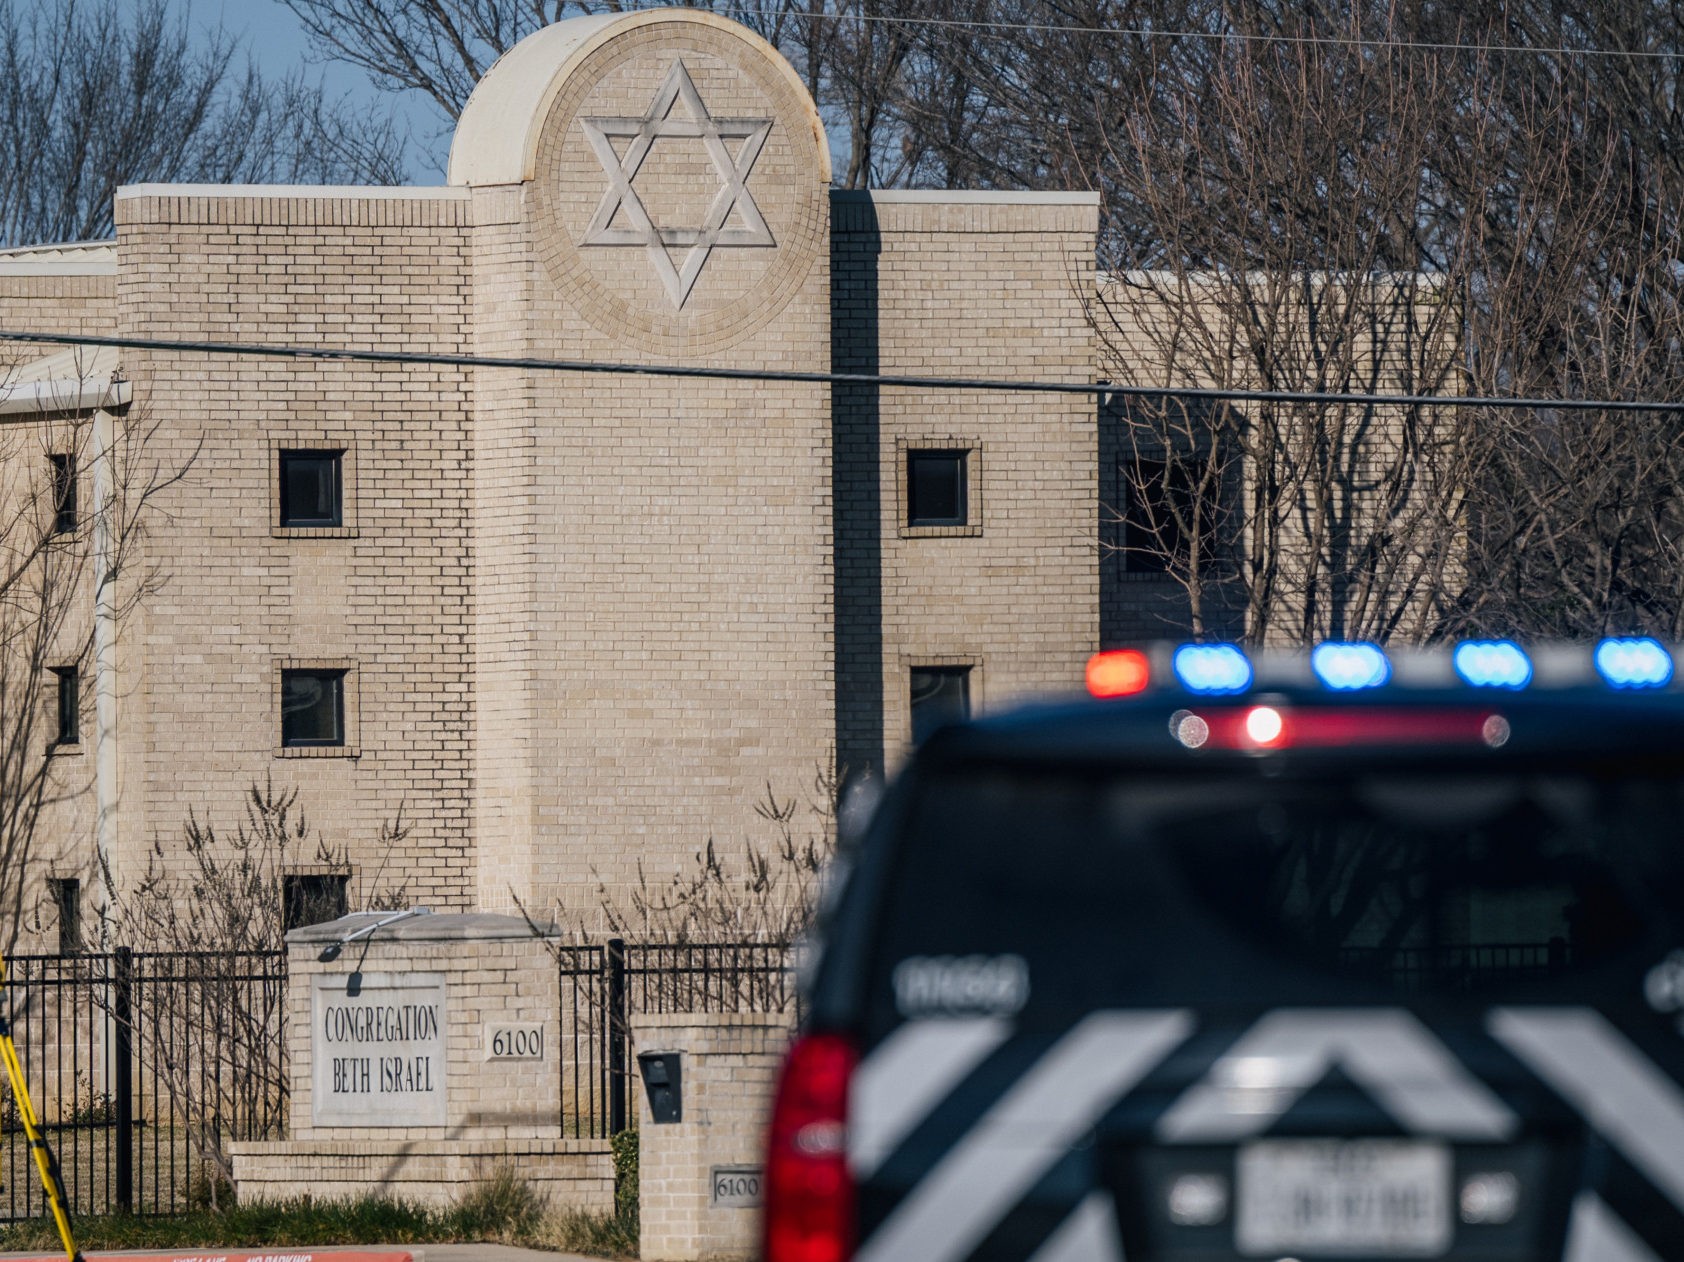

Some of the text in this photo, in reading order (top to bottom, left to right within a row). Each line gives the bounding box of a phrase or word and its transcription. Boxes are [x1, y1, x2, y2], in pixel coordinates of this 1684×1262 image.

[325, 1005, 439, 1043] CONGREGATION
[493, 1029, 540, 1056] 6100
[333, 1056, 434, 1093] BETH ISRAEL
[717, 1178, 759, 1197] 6100
